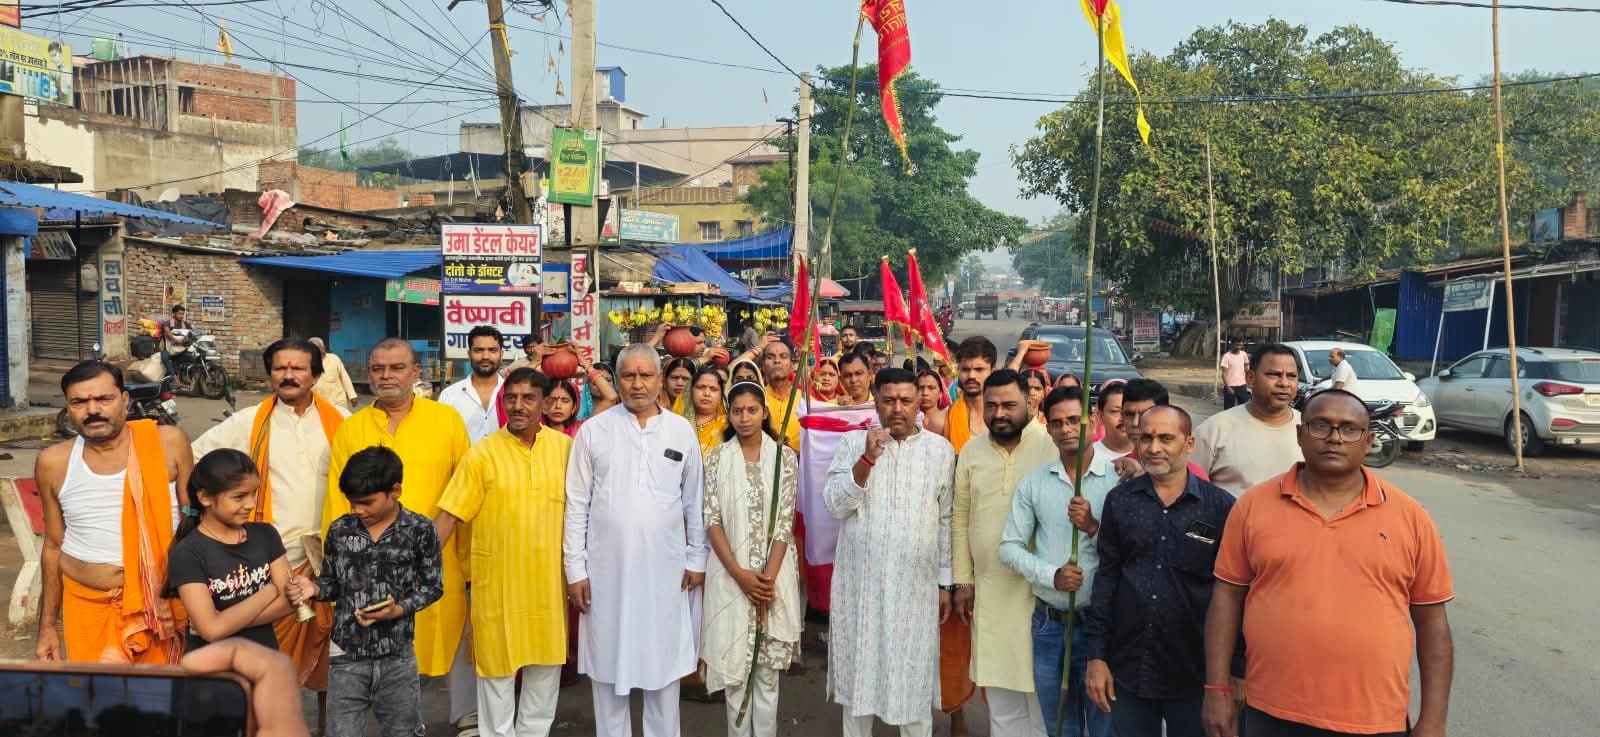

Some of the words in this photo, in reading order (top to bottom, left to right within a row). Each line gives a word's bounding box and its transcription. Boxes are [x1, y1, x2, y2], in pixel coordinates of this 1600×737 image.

[445, 232, 470, 253] उमा
[472, 227, 503, 253] डेंटल
[505, 227, 538, 253] केयर
[466, 263, 476, 277] के
[477, 263, 504, 278] डॉक्टर
[446, 299, 526, 326] वैष्णवी
